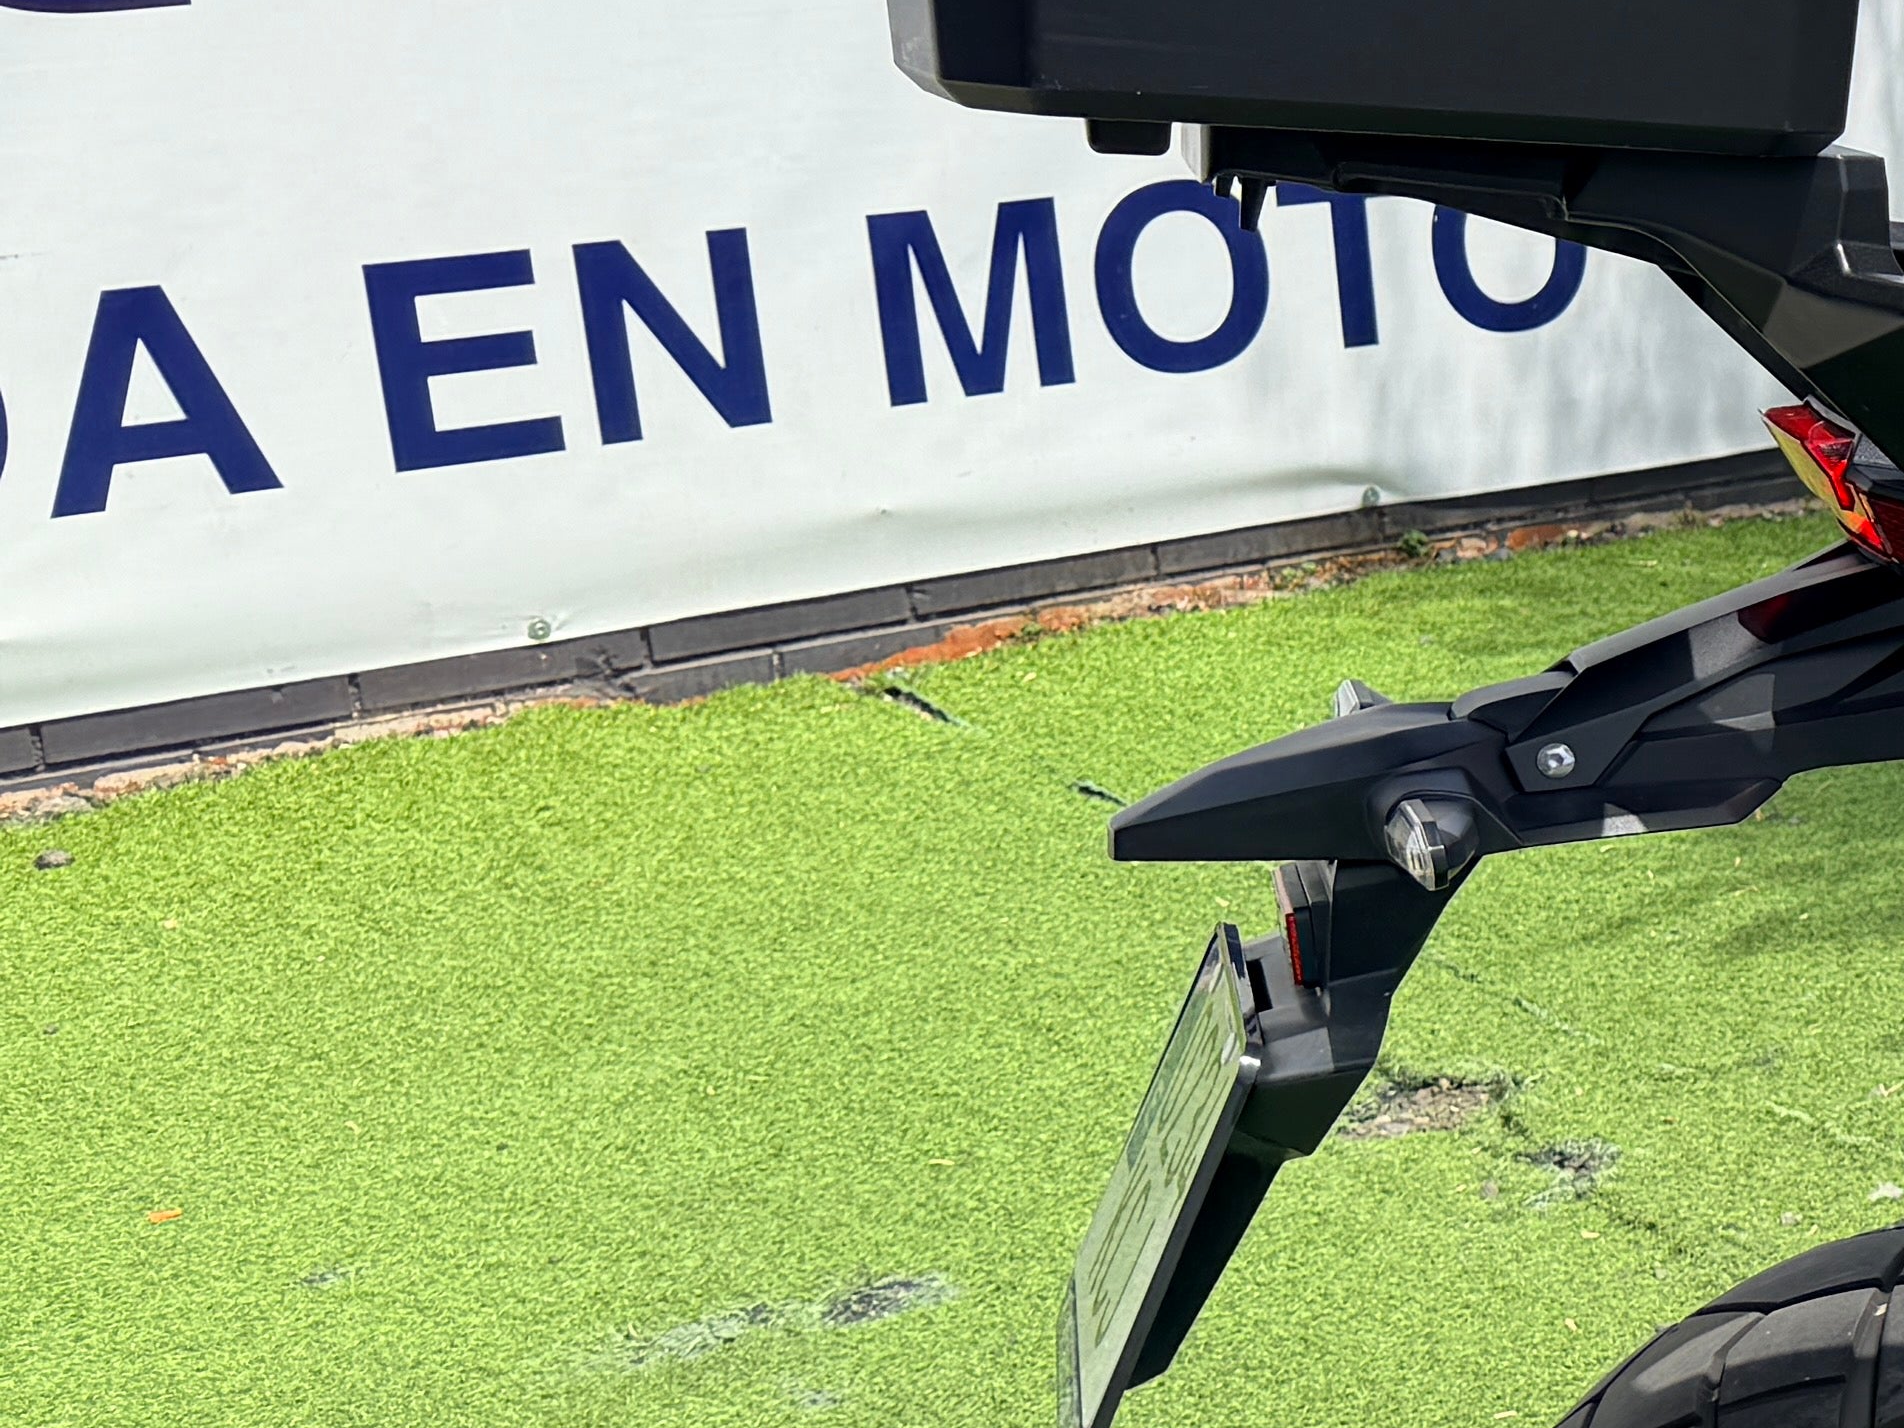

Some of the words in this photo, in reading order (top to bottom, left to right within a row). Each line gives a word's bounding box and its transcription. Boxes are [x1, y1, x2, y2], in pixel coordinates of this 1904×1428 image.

[0, 285, 284, 519] A
[362, 227, 773, 473] EN
[866, 179, 1588, 407] MOTO
